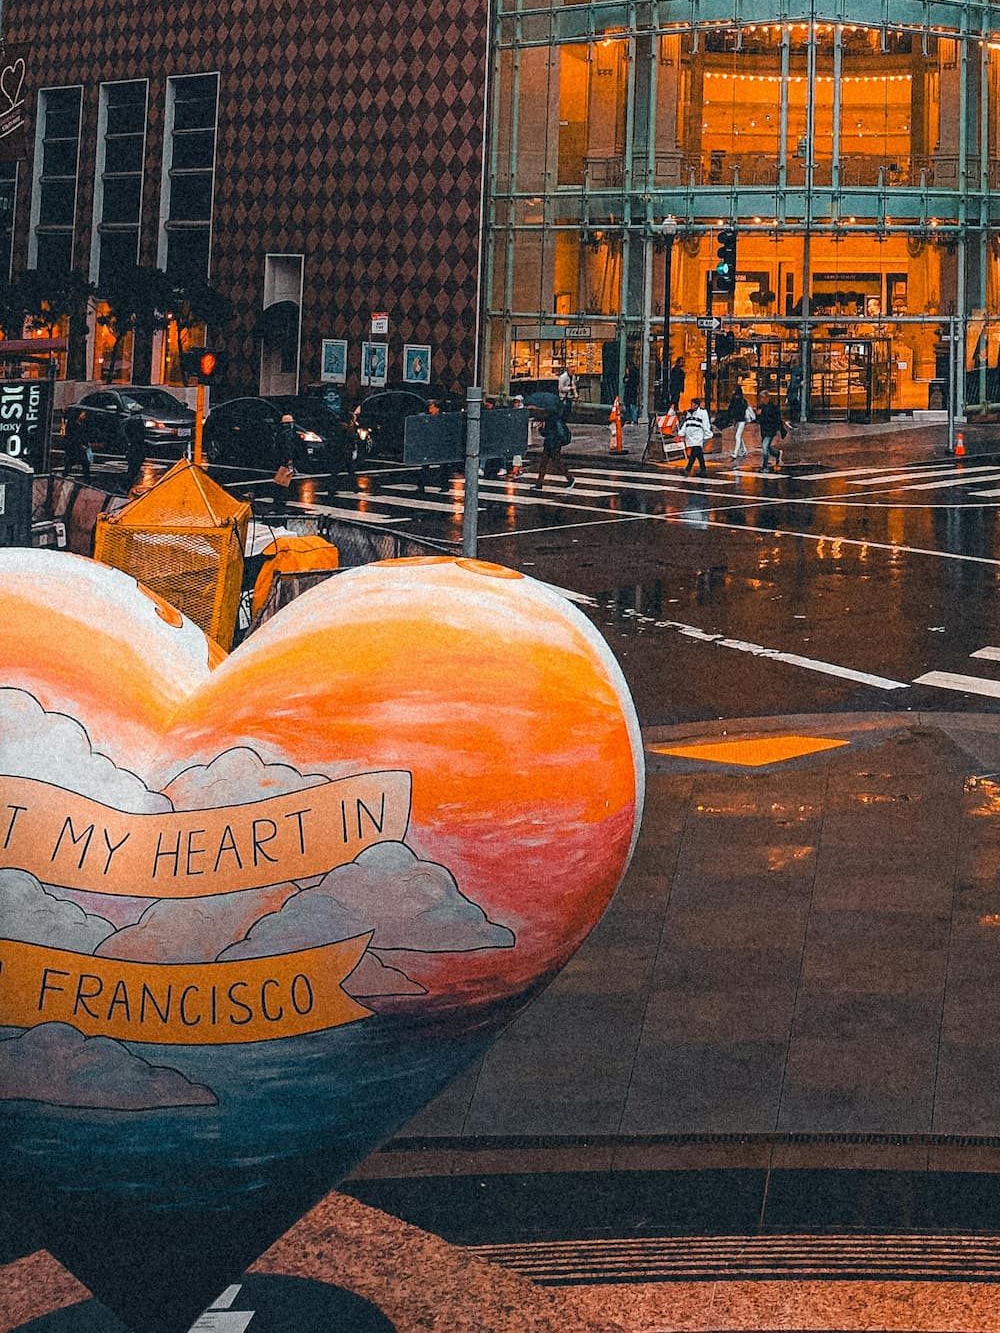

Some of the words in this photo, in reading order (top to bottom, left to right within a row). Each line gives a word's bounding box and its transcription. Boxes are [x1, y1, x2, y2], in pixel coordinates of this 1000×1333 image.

[51, 816, 131, 875] MY
[151, 808, 312, 878] HEART
[341, 792, 386, 843] IN
[37, 968, 315, 1026] FRANCISCO
